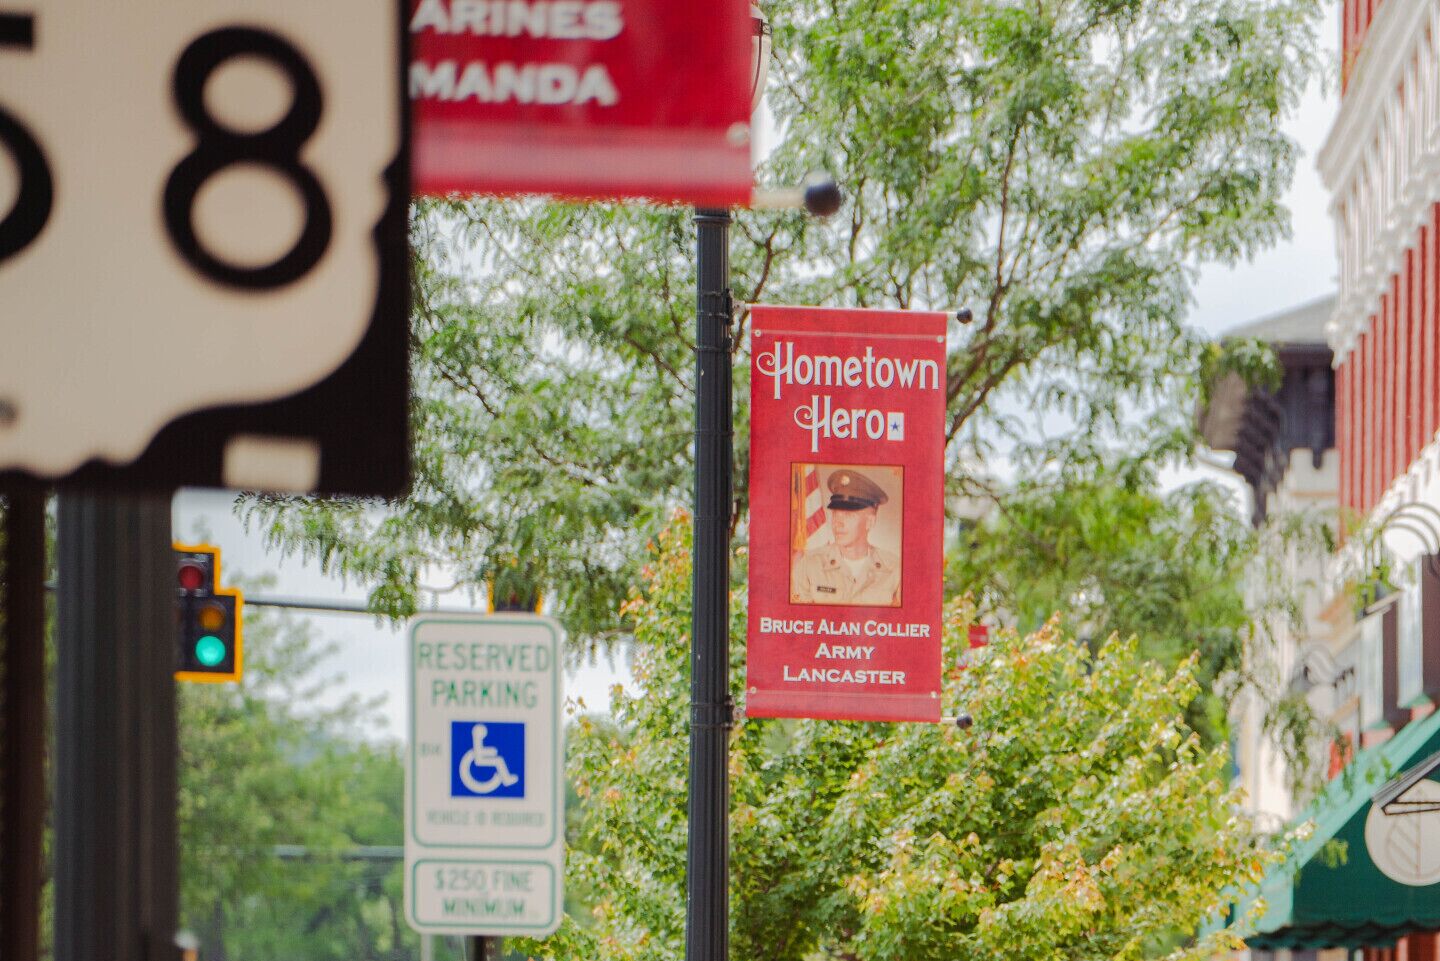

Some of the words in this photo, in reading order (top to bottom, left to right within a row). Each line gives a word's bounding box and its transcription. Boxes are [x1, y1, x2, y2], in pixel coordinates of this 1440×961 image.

[408, 0, 624, 41] ARINES
[407, 60, 620, 107] MANDA
[756, 341, 940, 400] Hometown
[793, 395, 885, 453] Hero
[759, 616, 814, 635] BRUCE
[817, 618, 861, 637] ALAN
[864, 620, 931, 638] COLLIER
[416, 642, 551, 673] RESERVED
[815, 642, 876, 661] ARMY
[783, 664, 907, 685] LANCASTER
[430, 679, 539, 708] PARKING
[435, 868, 486, 893] $250
[492, 868, 533, 893] FINE
[442, 896, 526, 918] MINIMUM
